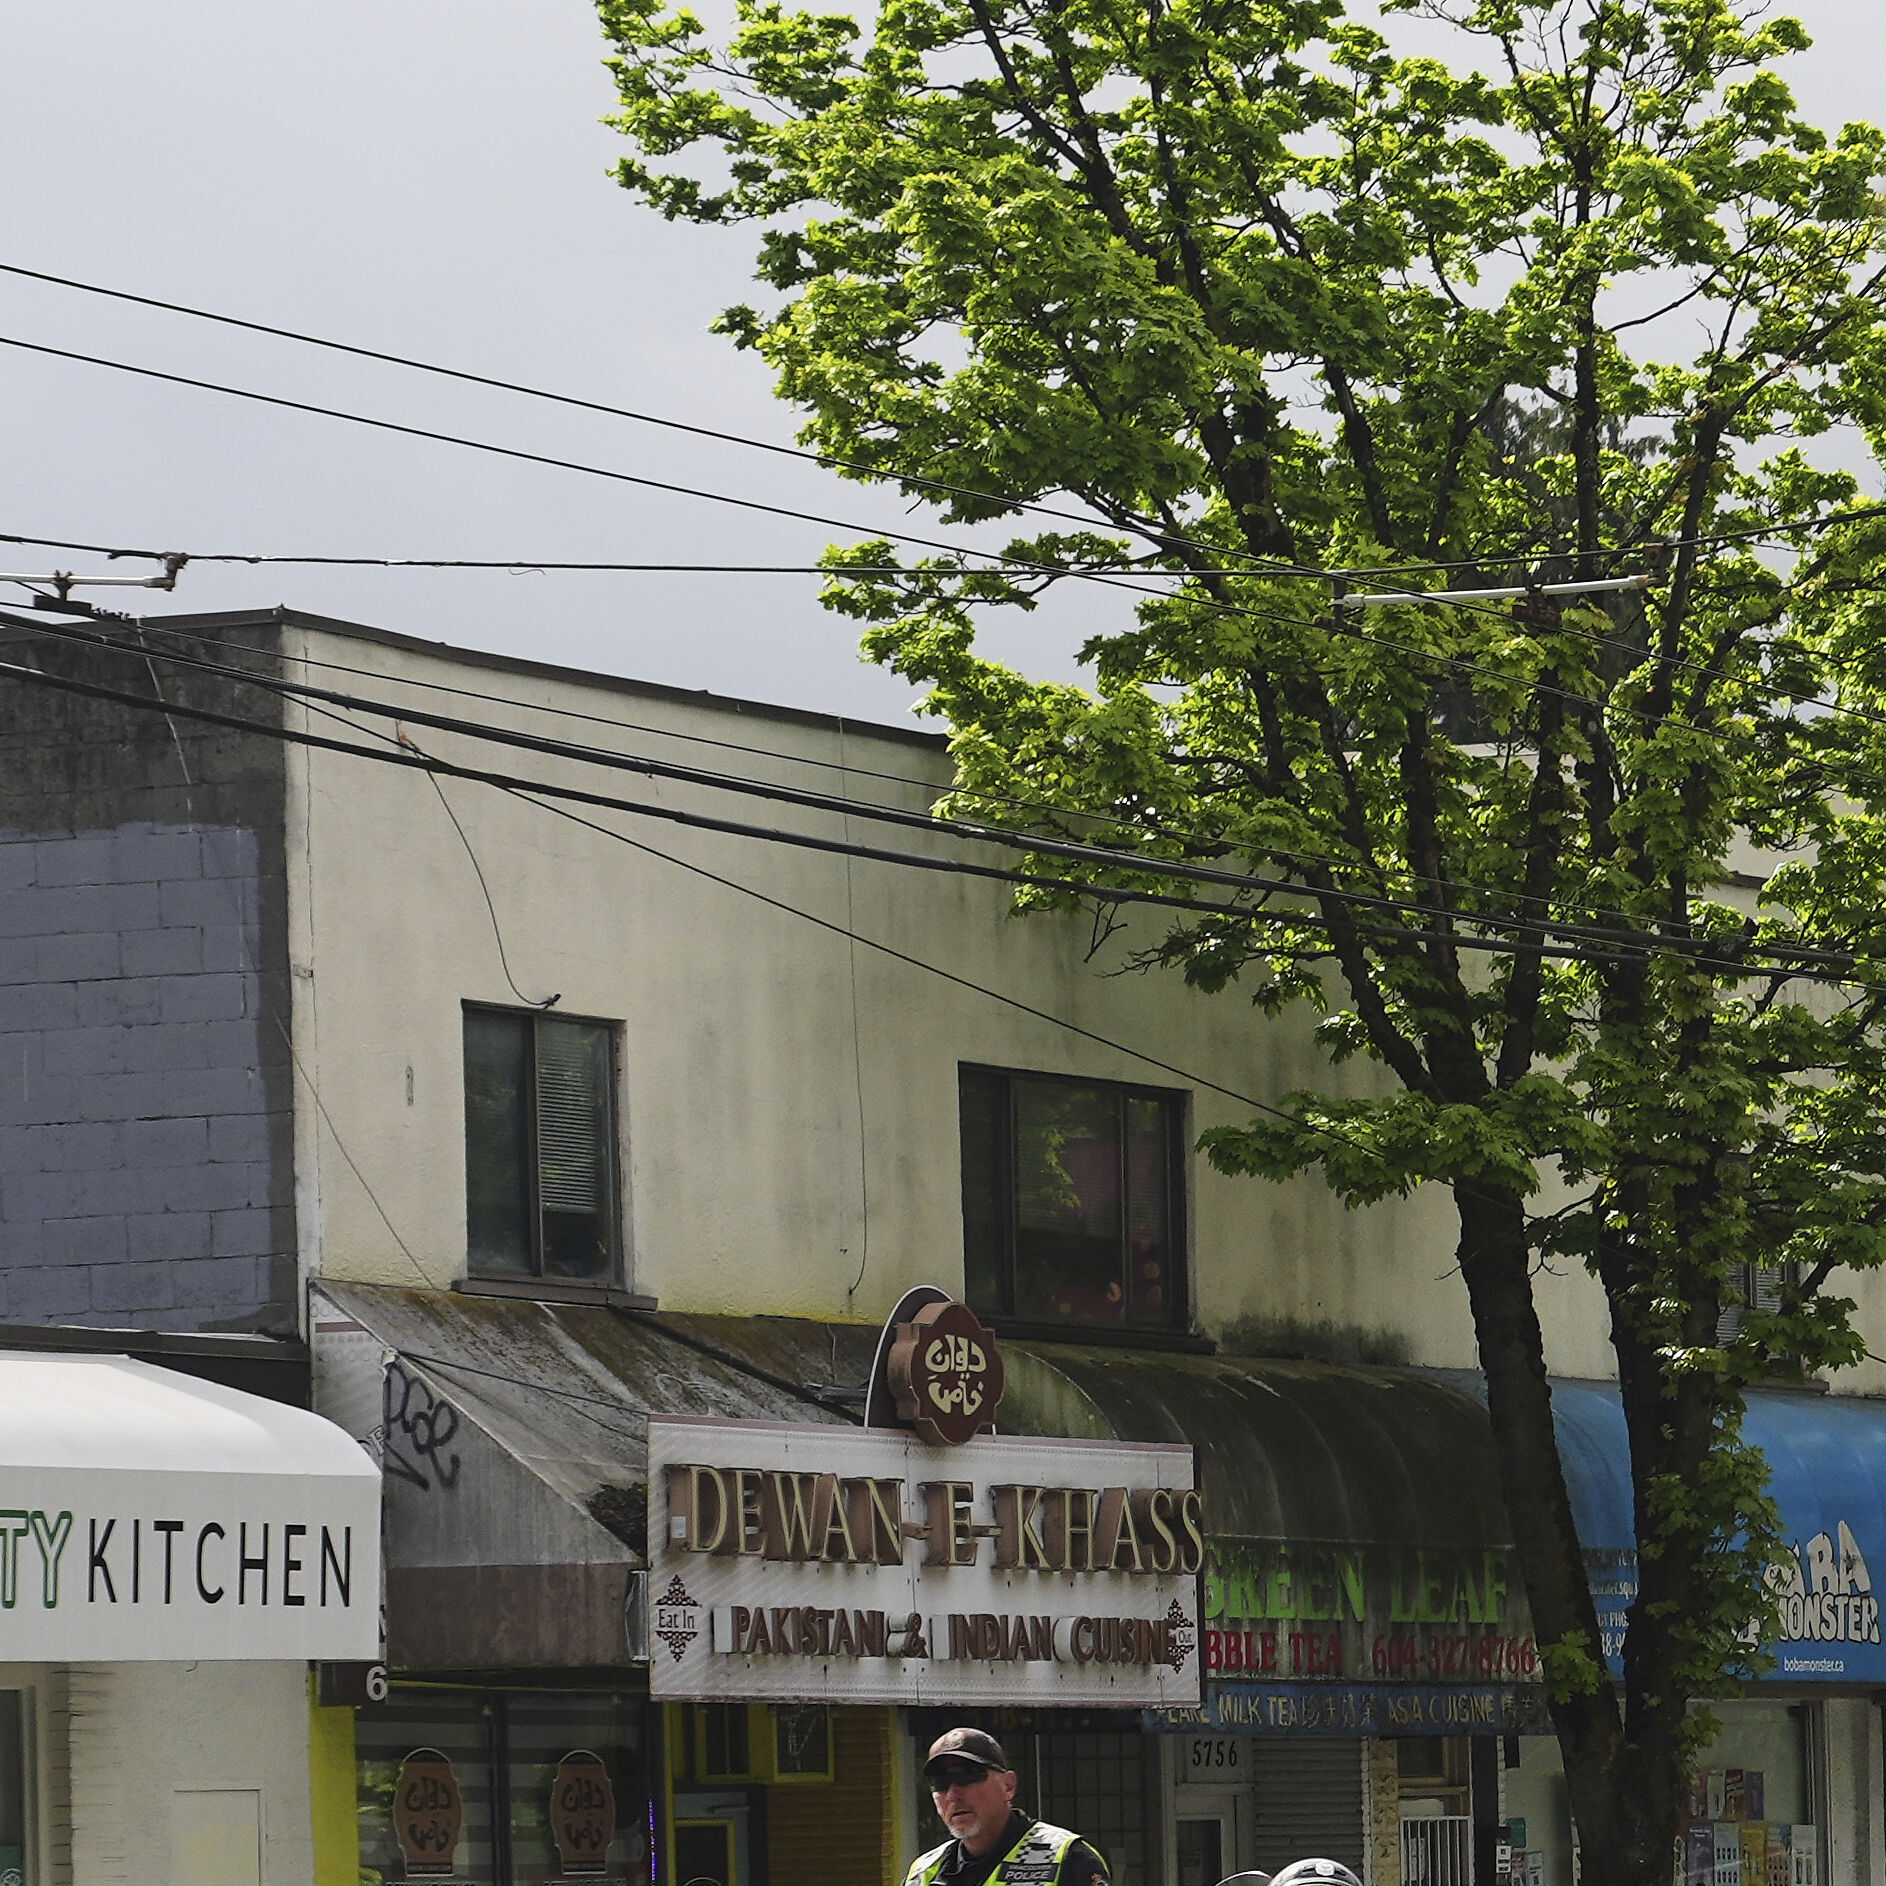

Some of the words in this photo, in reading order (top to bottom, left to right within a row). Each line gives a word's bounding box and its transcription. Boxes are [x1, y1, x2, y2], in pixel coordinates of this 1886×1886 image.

[0, 1510, 72, 1609] TY
[88, 1518, 352, 1608] KITCHEN
[1390, 1548, 1508, 1623] LEAF
[659, 1609, 679, 1628] Eat
[683, 1609, 695, 1628] In
[730, 1605, 887, 1658] PAKISTANI
[902, 1612, 928, 1658] &
[947, 1613, 1053, 1662] INDIAN
[1289, 1632, 1344, 1672] TEA
[1218, 1694, 1262, 1725] MILK
[1267, 1696, 1298, 1726] TEA
[1192, 1739, 1238, 1767] 5756
[1004, 1870, 1051, 1880] POLICE
